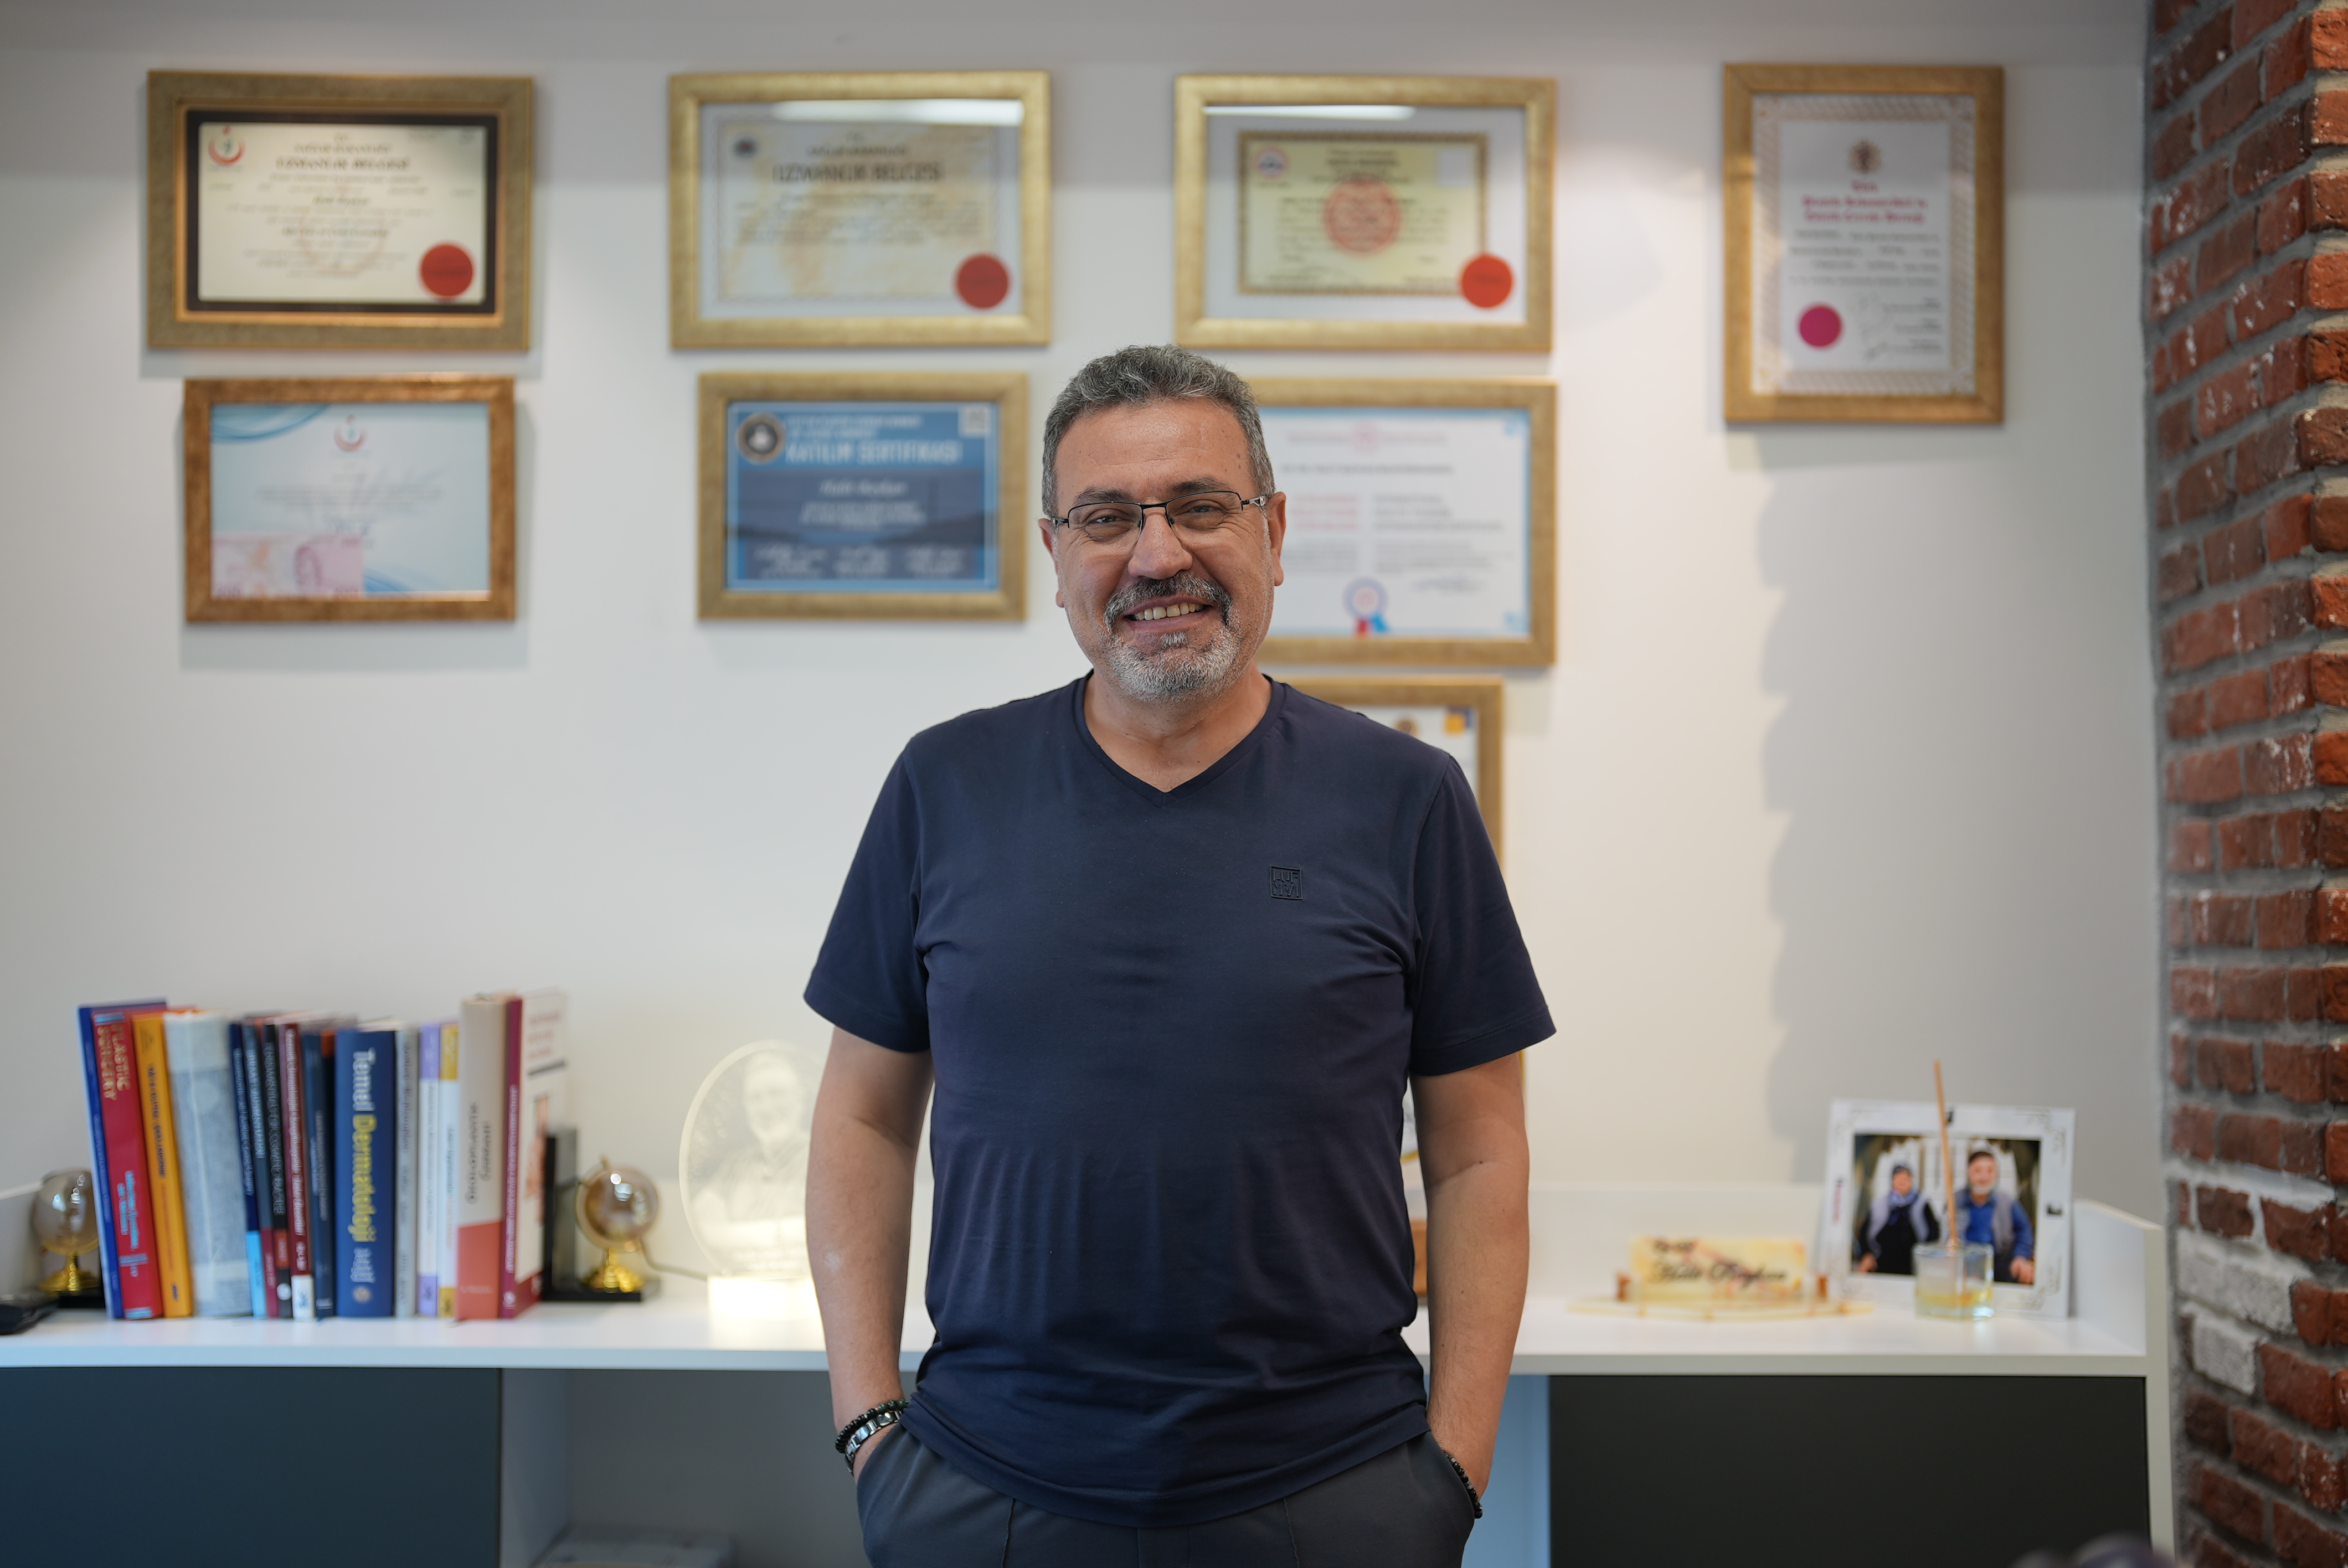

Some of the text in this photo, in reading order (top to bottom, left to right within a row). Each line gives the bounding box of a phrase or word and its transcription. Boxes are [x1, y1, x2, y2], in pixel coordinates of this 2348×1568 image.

[96, 1025, 117, 1101] SURGERY
[112, 1024, 131, 1092] PLASTIC
[352, 1048, 375, 1112] Temel
[348, 1114, 377, 1243] Dermatoloji
